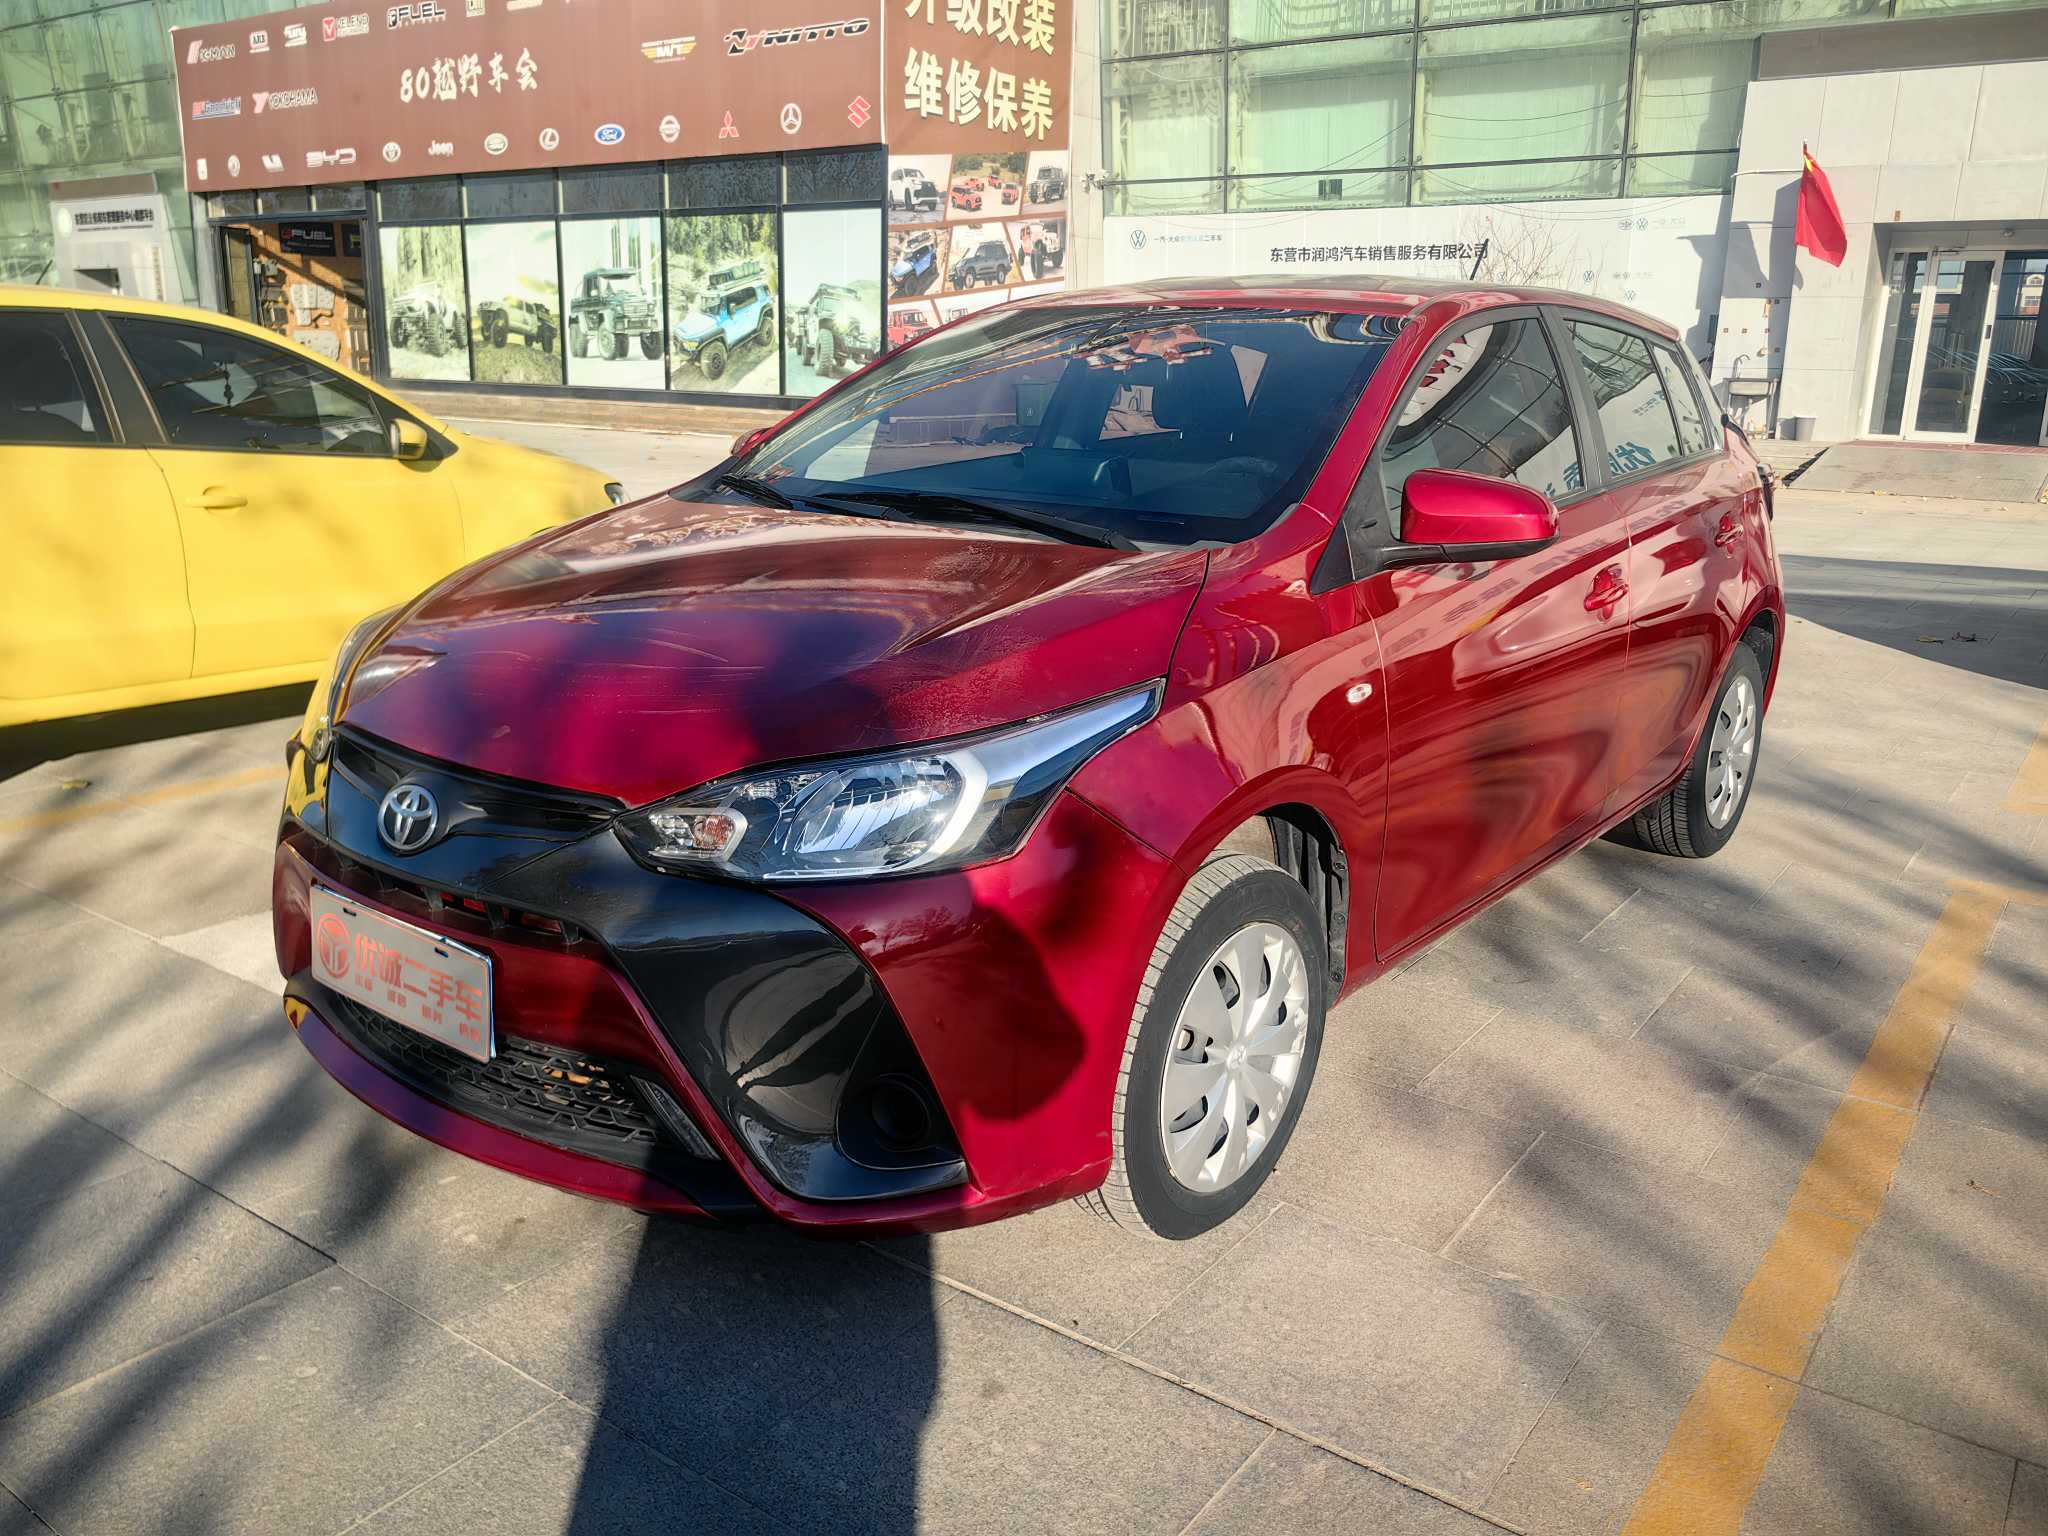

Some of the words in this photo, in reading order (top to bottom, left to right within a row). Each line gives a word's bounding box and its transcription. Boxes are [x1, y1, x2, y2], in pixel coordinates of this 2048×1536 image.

[397, 2, 445, 21] FUEL
[763, 18, 870, 47] NITTO
[400, 48, 538, 103] 80越野车会
[252, 88, 319, 113] YOKOHAMA
[904, 47, 1054, 140] 维修保养
[306, 147, 357, 168] BYD
[428, 140, 454, 157] Jeep
[1270, 243, 1488, 263] 东营市润鸿汽车销售服务有限公司
